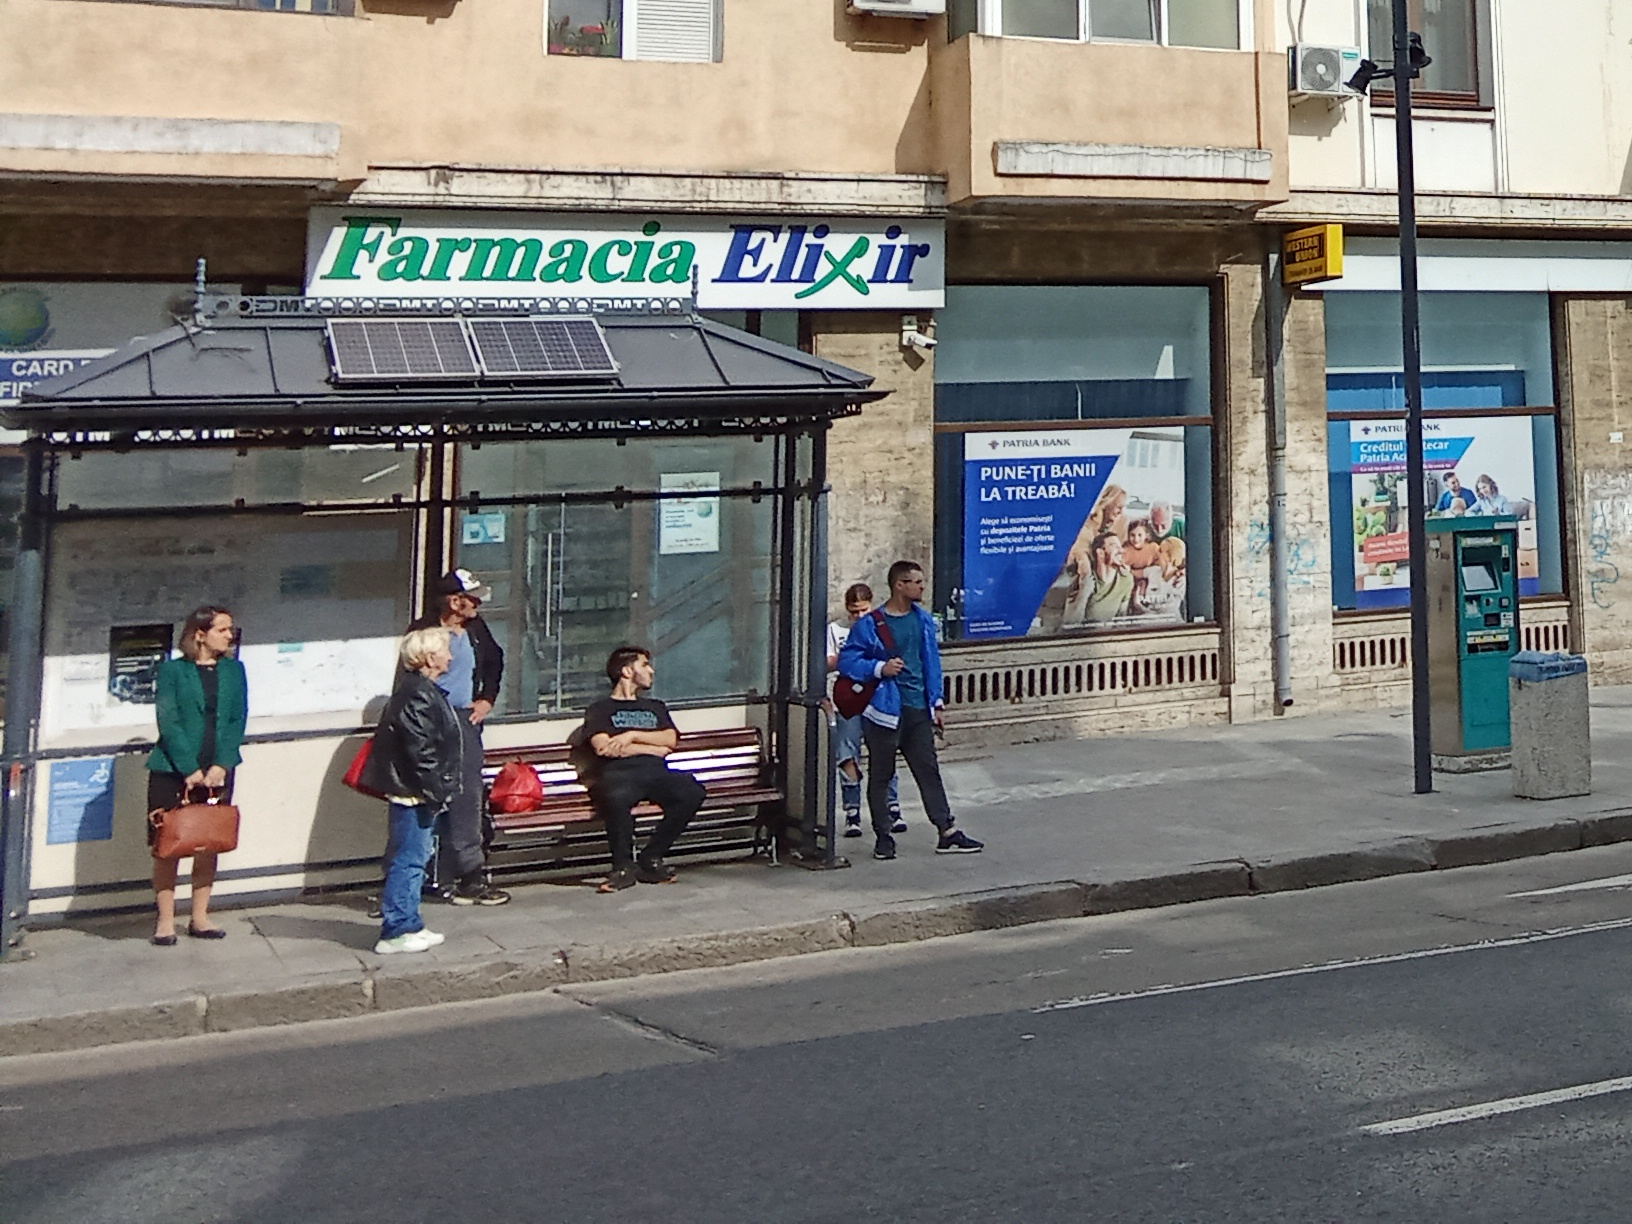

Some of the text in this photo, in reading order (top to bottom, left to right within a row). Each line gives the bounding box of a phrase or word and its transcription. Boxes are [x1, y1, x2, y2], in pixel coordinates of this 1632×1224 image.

[320, 216, 930, 300] Farmacia Elixir
[11, 360, 75, 377] CARD
[1002, 437, 1071, 448] PATRIA BANK
[1360, 440, 1450, 453] Creditul tecar
[1360, 454, 1391, 463] Patria
[1050, 462, 1096, 478] BANII
[980, 481, 1075, 502] LA TREABĂ!
[1029, 524, 1051, 533] Patria
